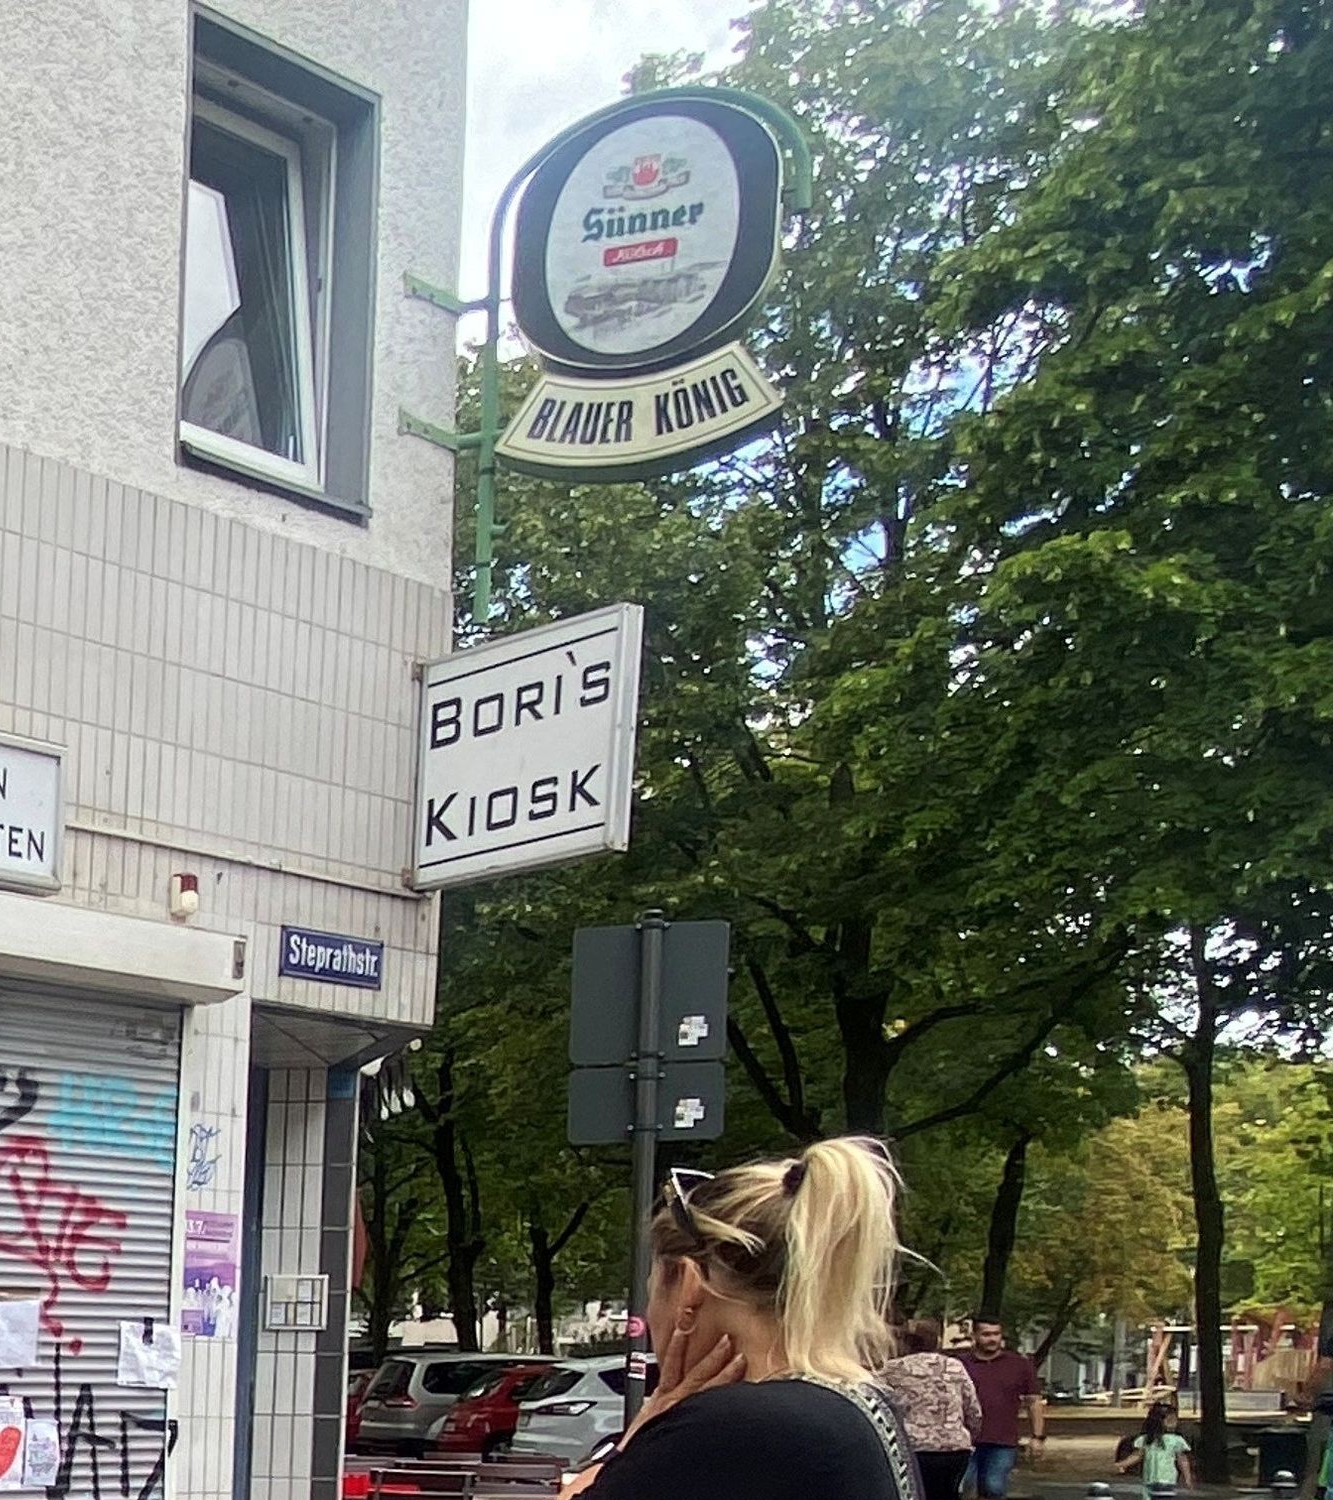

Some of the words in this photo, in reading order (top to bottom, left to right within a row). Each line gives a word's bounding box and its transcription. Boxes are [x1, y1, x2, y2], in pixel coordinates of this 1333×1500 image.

[580, 201, 704, 243] Sünner
[527, 397, 633, 445] BLAUER
[654, 367, 749, 438] KÖNIG
[424, 764, 601, 847] KIOSK
[288, 934, 379, 978] Steprathstr.
